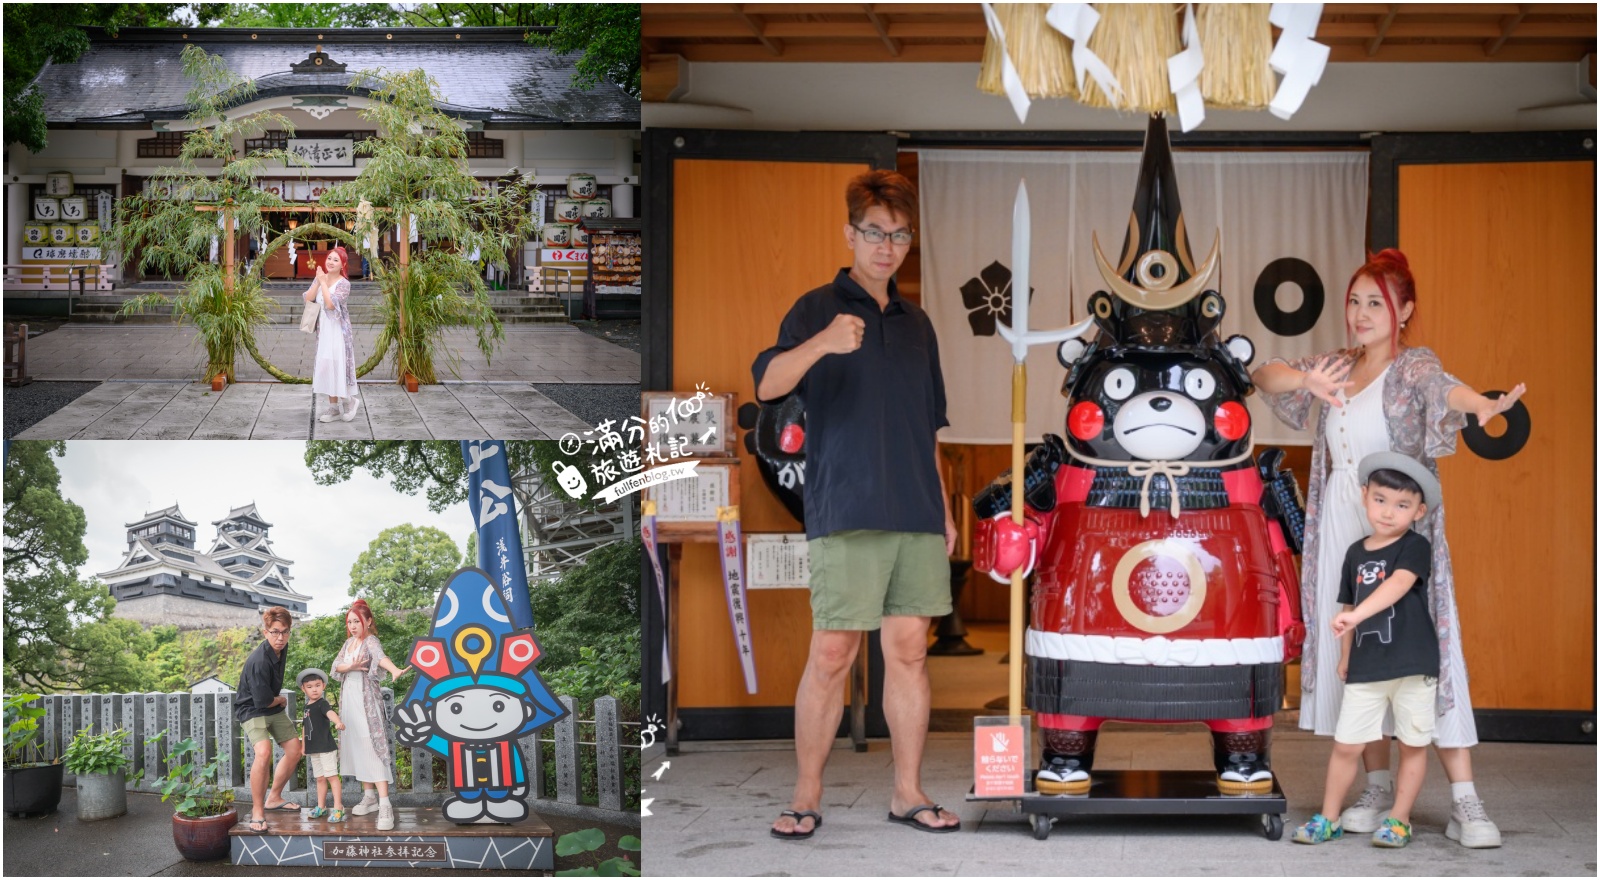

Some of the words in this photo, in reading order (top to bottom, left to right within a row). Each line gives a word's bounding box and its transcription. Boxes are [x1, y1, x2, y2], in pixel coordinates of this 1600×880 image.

[36, 203, 55, 218] しろ
[61, 203, 81, 218] しろ
[724, 530, 737, 558] 感謝
